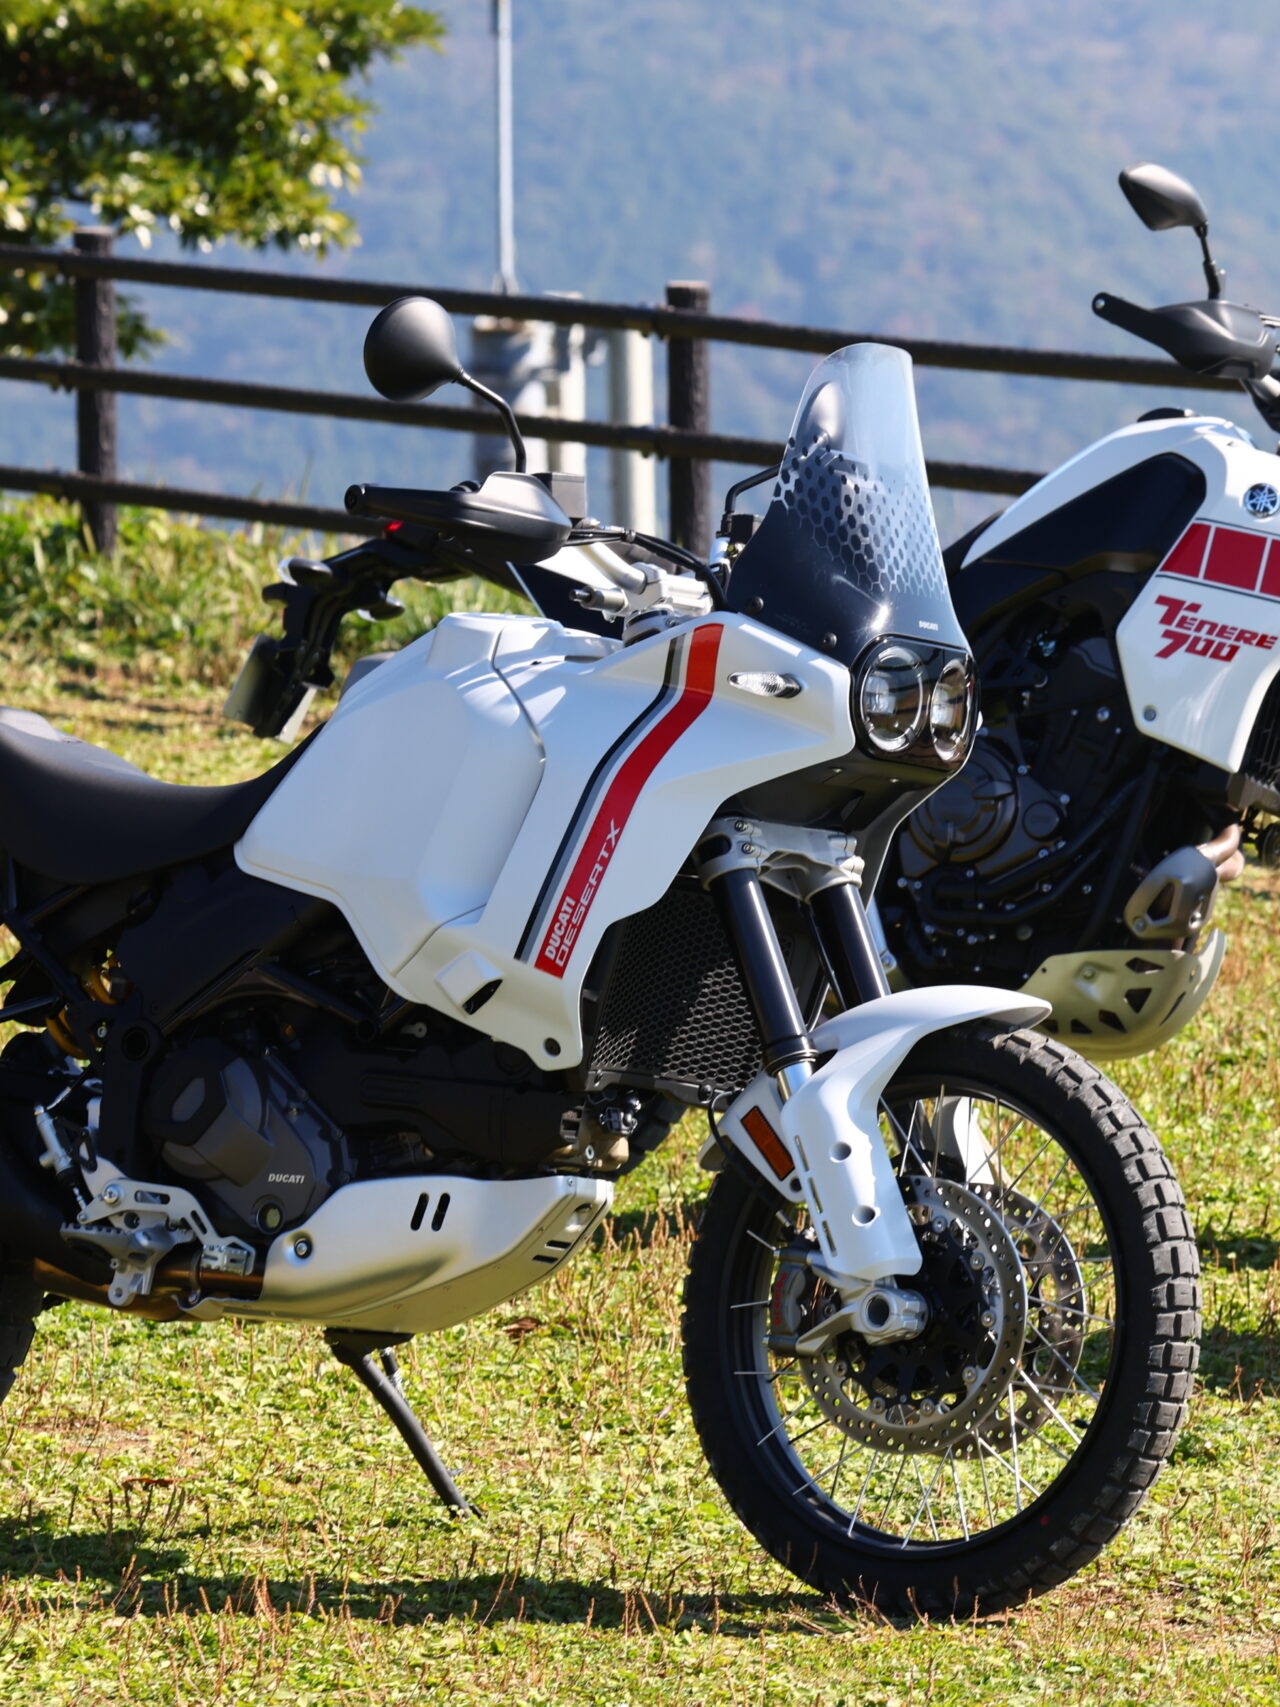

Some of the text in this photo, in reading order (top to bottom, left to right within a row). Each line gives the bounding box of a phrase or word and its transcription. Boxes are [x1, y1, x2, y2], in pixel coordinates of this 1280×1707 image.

[919, 621, 939, 632] DUCATI
[1154, 629, 1240, 663] 700
[544, 895, 575, 960] DUCATI
[267, 1173, 305, 1184] DUCATI
